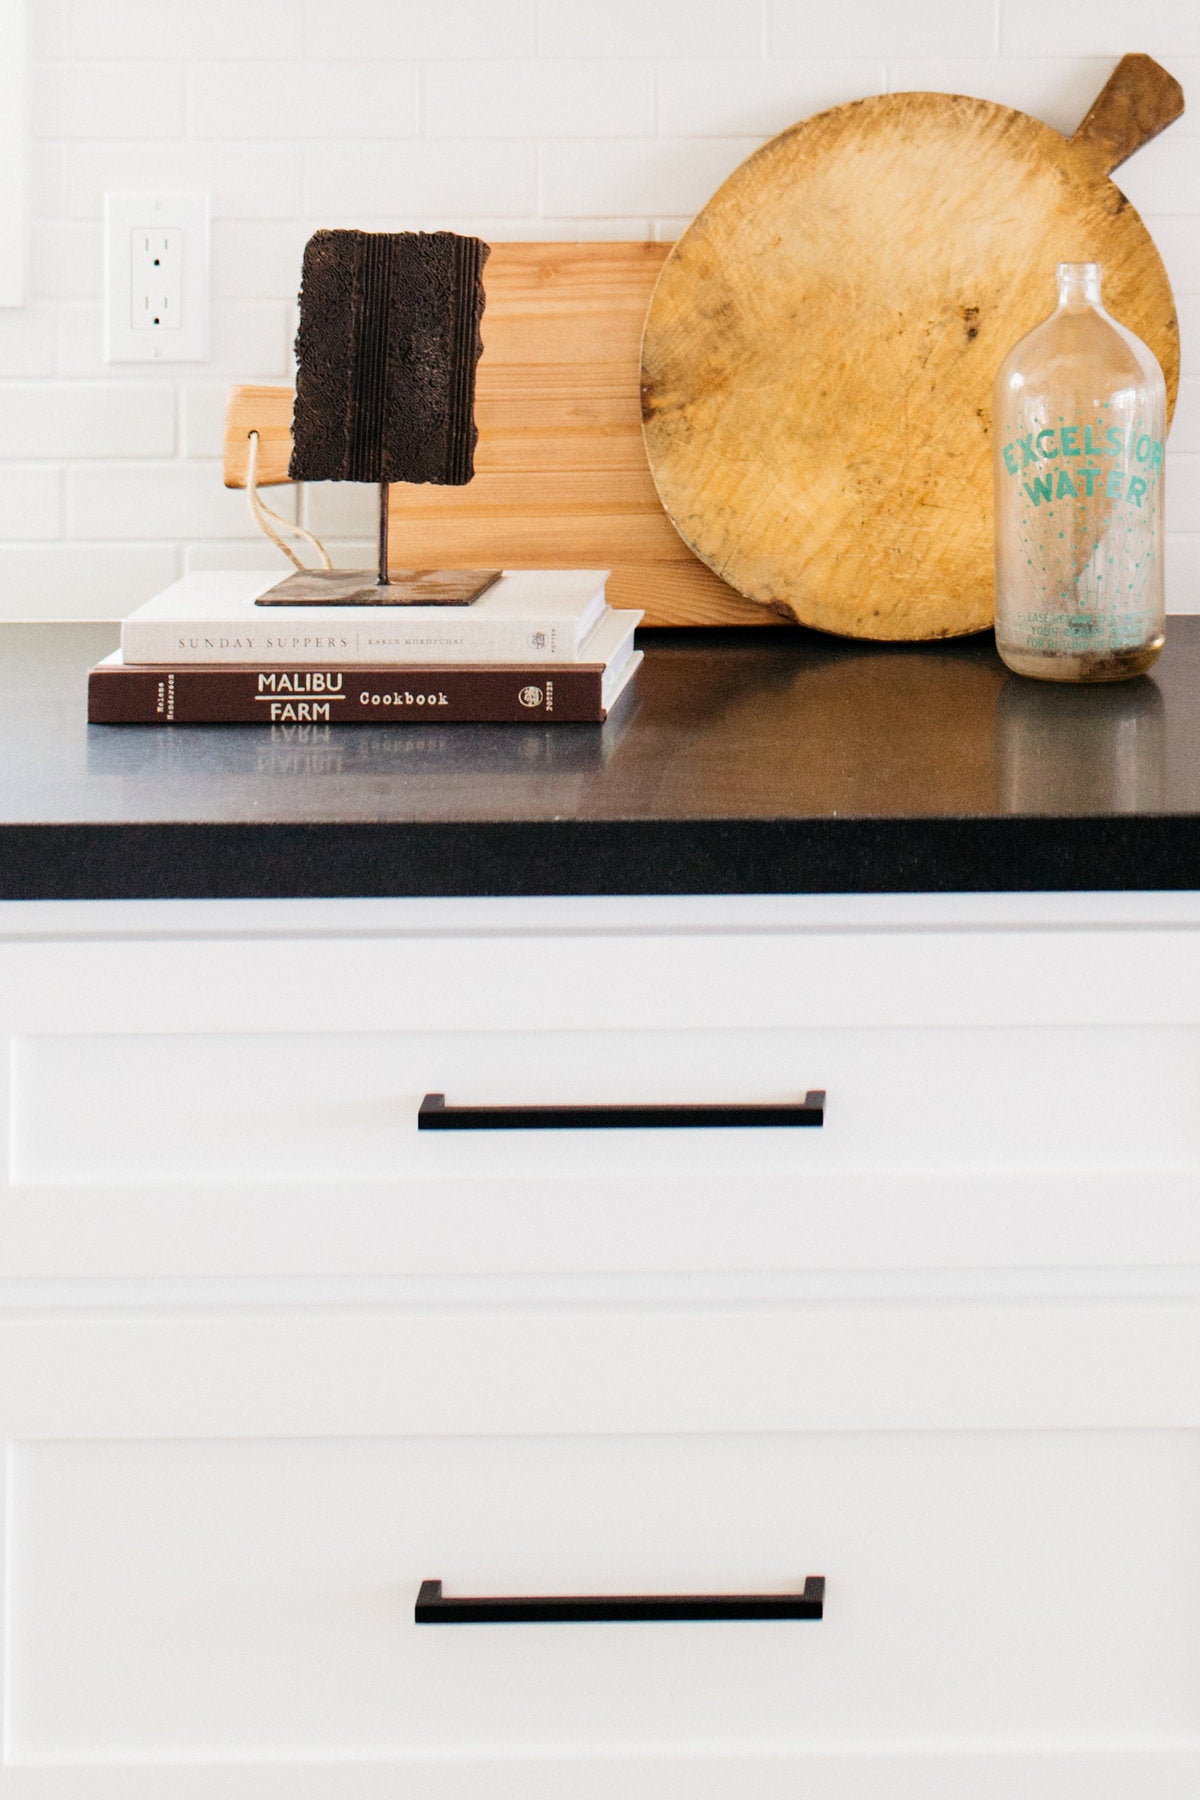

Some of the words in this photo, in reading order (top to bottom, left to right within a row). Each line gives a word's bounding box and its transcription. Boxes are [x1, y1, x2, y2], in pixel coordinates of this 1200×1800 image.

[1003, 424, 1164, 476] EXCELSIOR
[1023, 468, 1148, 508] WATER
[178, 637, 255, 648] SUNDAY
[267, 637, 348, 648] SUPPERS
[258, 673, 343, 692] MALIBU
[157, 682, 165, 713] Helene
[360, 691, 449, 706] Cookbook
[270, 703, 331, 721] FARM
